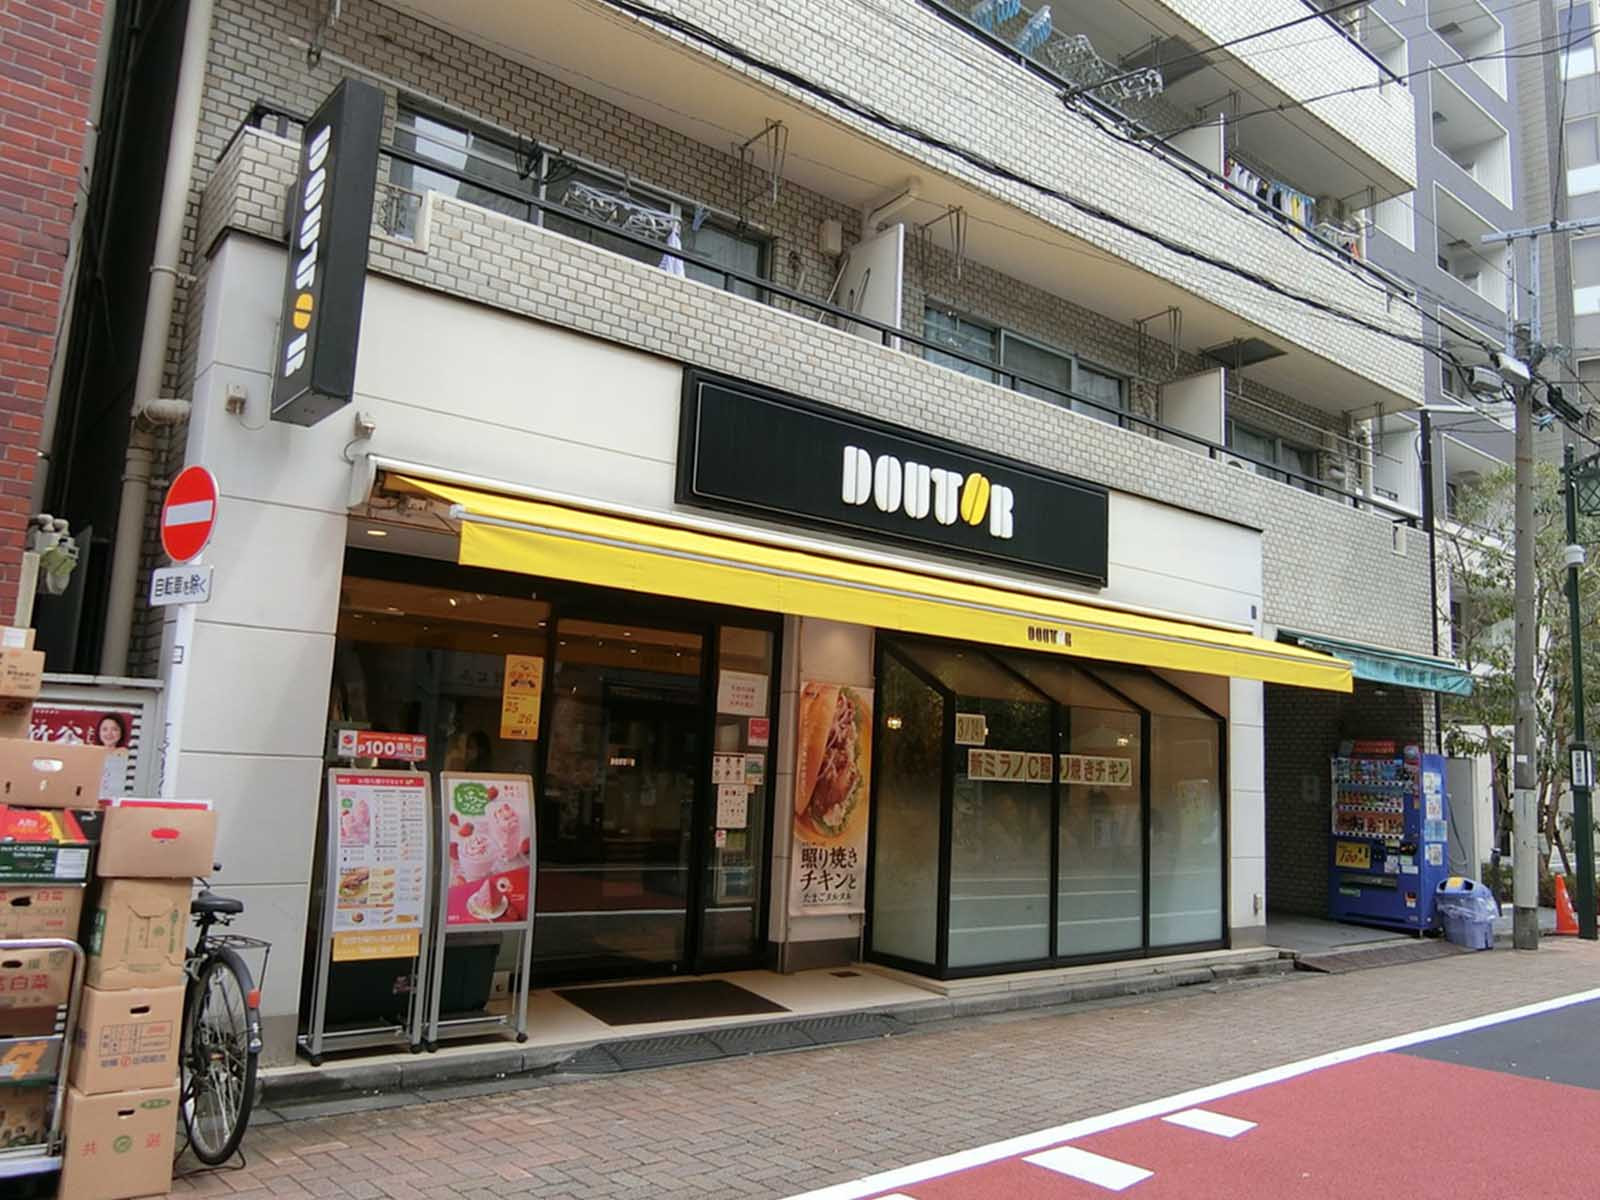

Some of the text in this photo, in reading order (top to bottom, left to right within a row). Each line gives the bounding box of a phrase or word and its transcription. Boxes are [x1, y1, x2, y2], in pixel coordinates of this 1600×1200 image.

[285, 124, 332, 377] DOUTOR
[842, 445, 1014, 539] DOUTOR
[1028, 625, 1072, 648] DOUTOR
[800, 846, 858, 869] 照り焼き
[800, 869, 857, 892] チキンと
